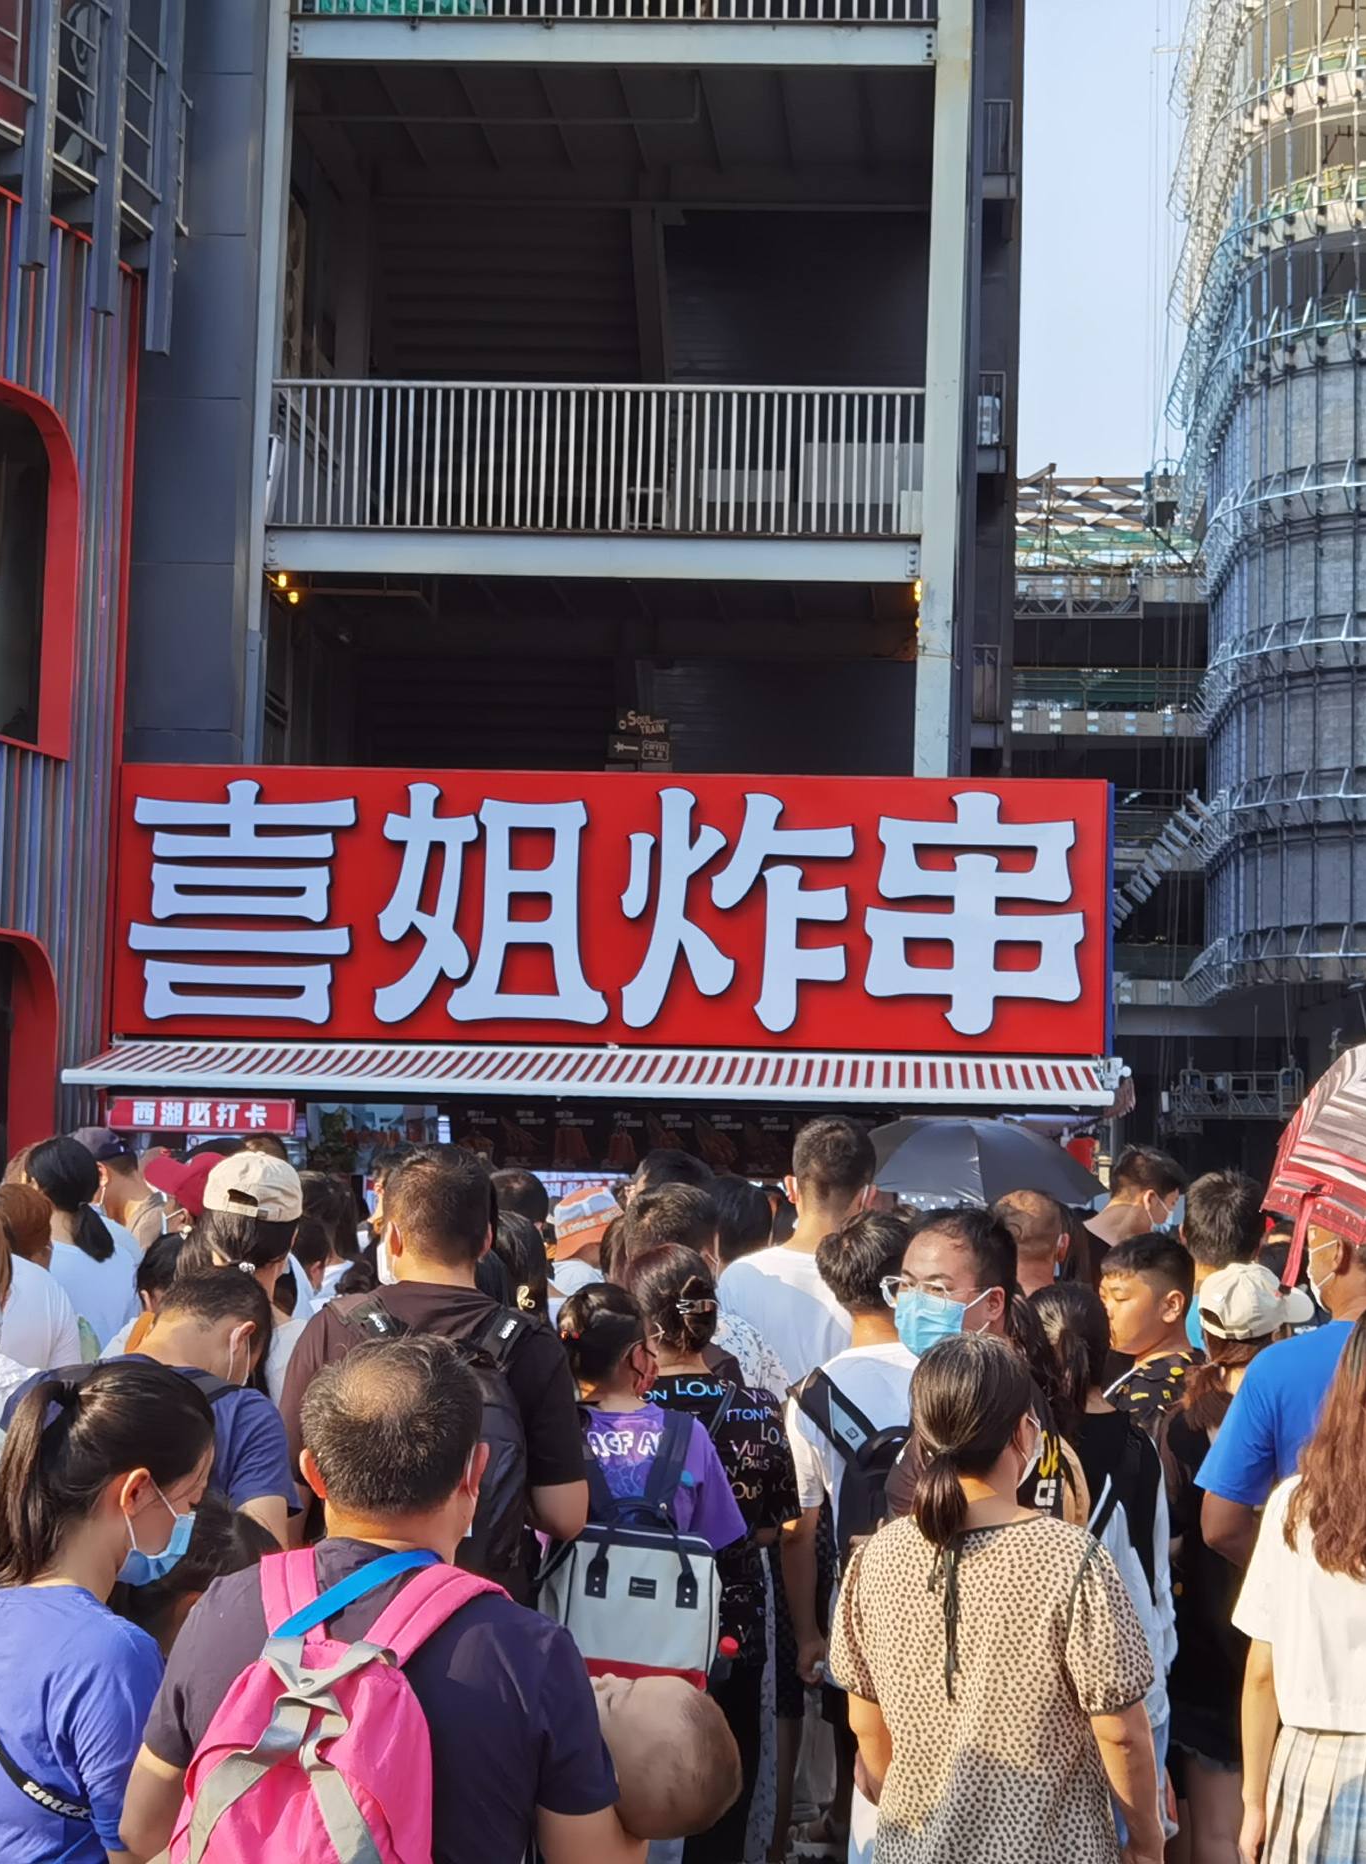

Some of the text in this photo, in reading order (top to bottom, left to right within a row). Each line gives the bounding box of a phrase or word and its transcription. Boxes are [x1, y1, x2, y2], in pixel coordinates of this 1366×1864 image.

[127, 778, 1086, 1036] 喜姐炸串
[132, 1100, 268, 1128] 西湖必打卡
